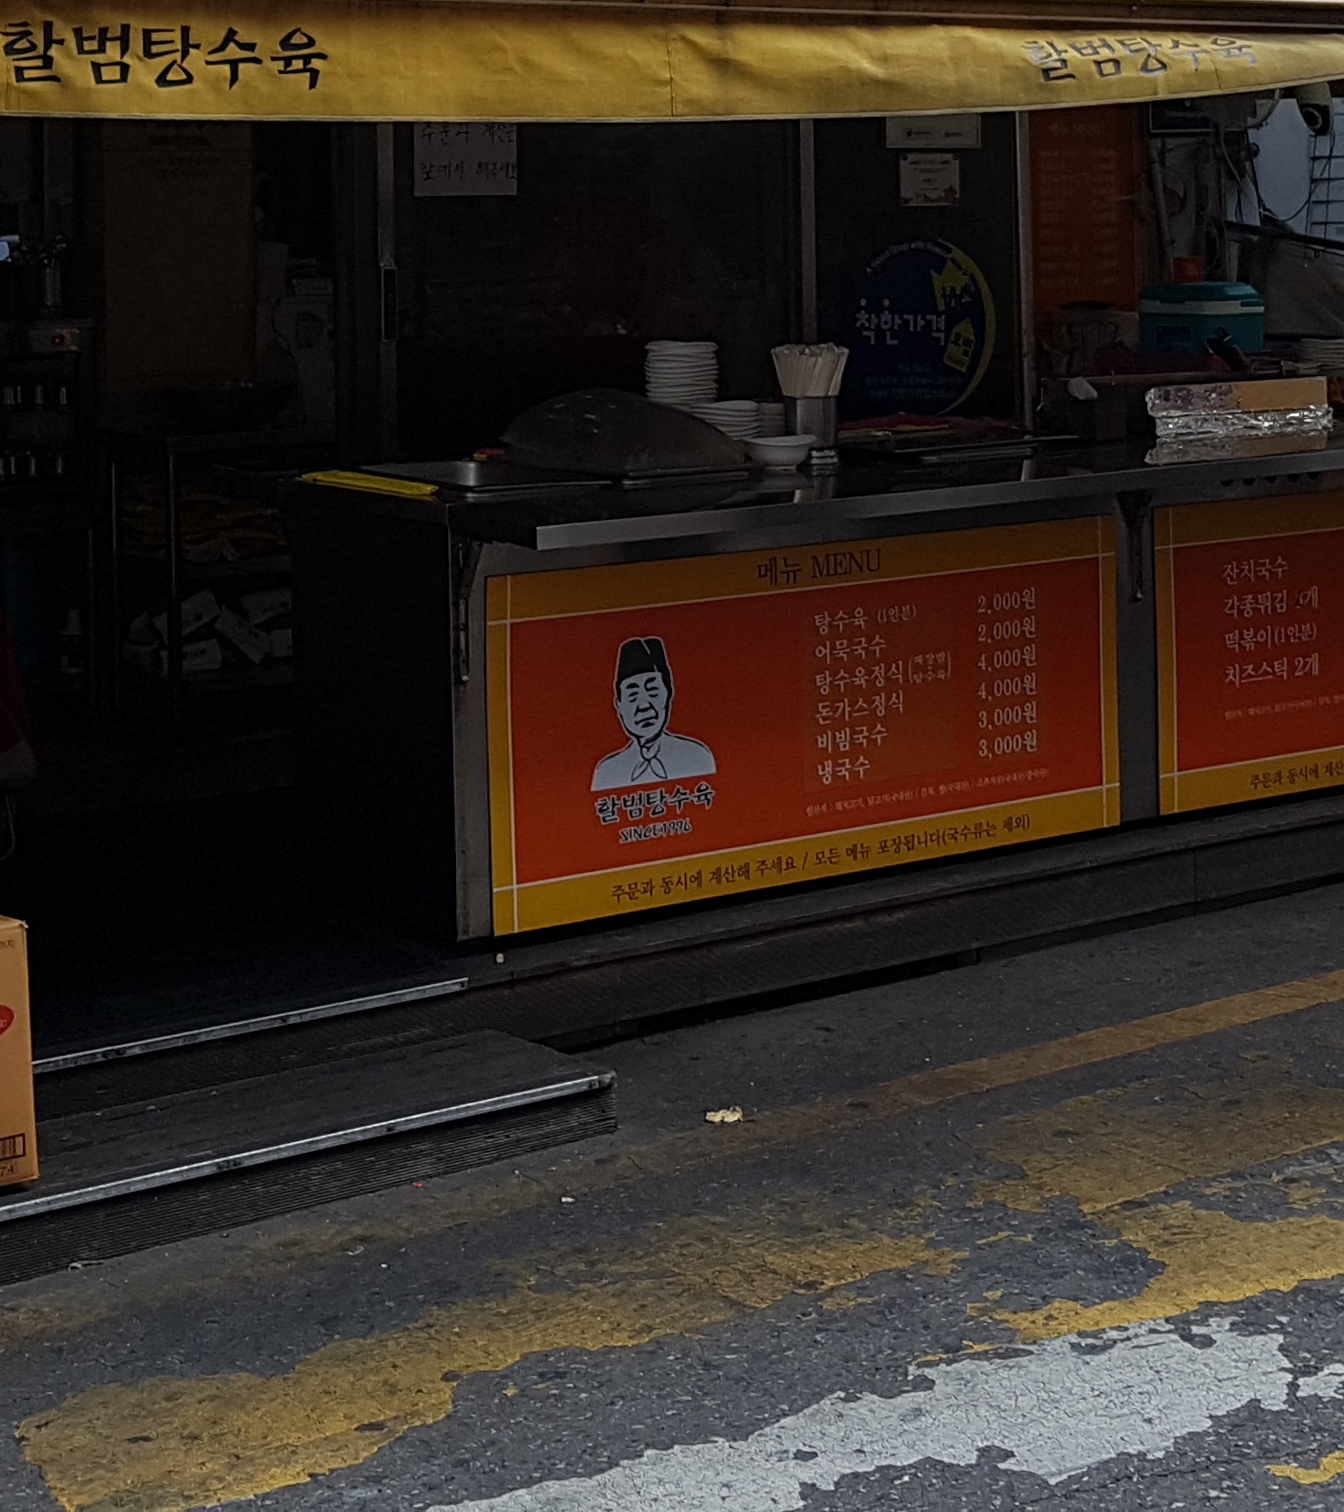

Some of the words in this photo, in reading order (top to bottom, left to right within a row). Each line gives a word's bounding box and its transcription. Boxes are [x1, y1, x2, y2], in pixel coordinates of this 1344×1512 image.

[0, 20, 328, 90] 할범탕수육
[1021, 37, 1256, 82] 할범탕수육
[855, 298, 946, 346] 착한가격
[757, 556, 802, 585] 메뉴
[811, 549, 882, 578] MENU
[1223, 555, 1288, 585] 잔치국수
[814, 607, 868, 635] 탕수육
[1224, 590, 1287, 619] 각종튀김
[815, 634, 886, 664] 어묵국수
[815, 660, 904, 696] 탕수육정식
[1225, 657, 1287, 688] 치즈스틱
[1294, 653, 1319, 677] 2개
[815, 690, 904, 725] 돈가스정식
[816, 723, 888, 754] 비빔국수
[817, 755, 871, 785] 냉국수
[595, 781, 715, 826] 할범탕수육
[612, 879, 656, 903] 주문과
[660, 870, 703, 893] 동시에
[709, 862, 750, 886] 계산해
[756, 856, 797, 877] 주세요
[814, 847, 841, 865] 모든
[846, 842, 871, 861] 메뉴
